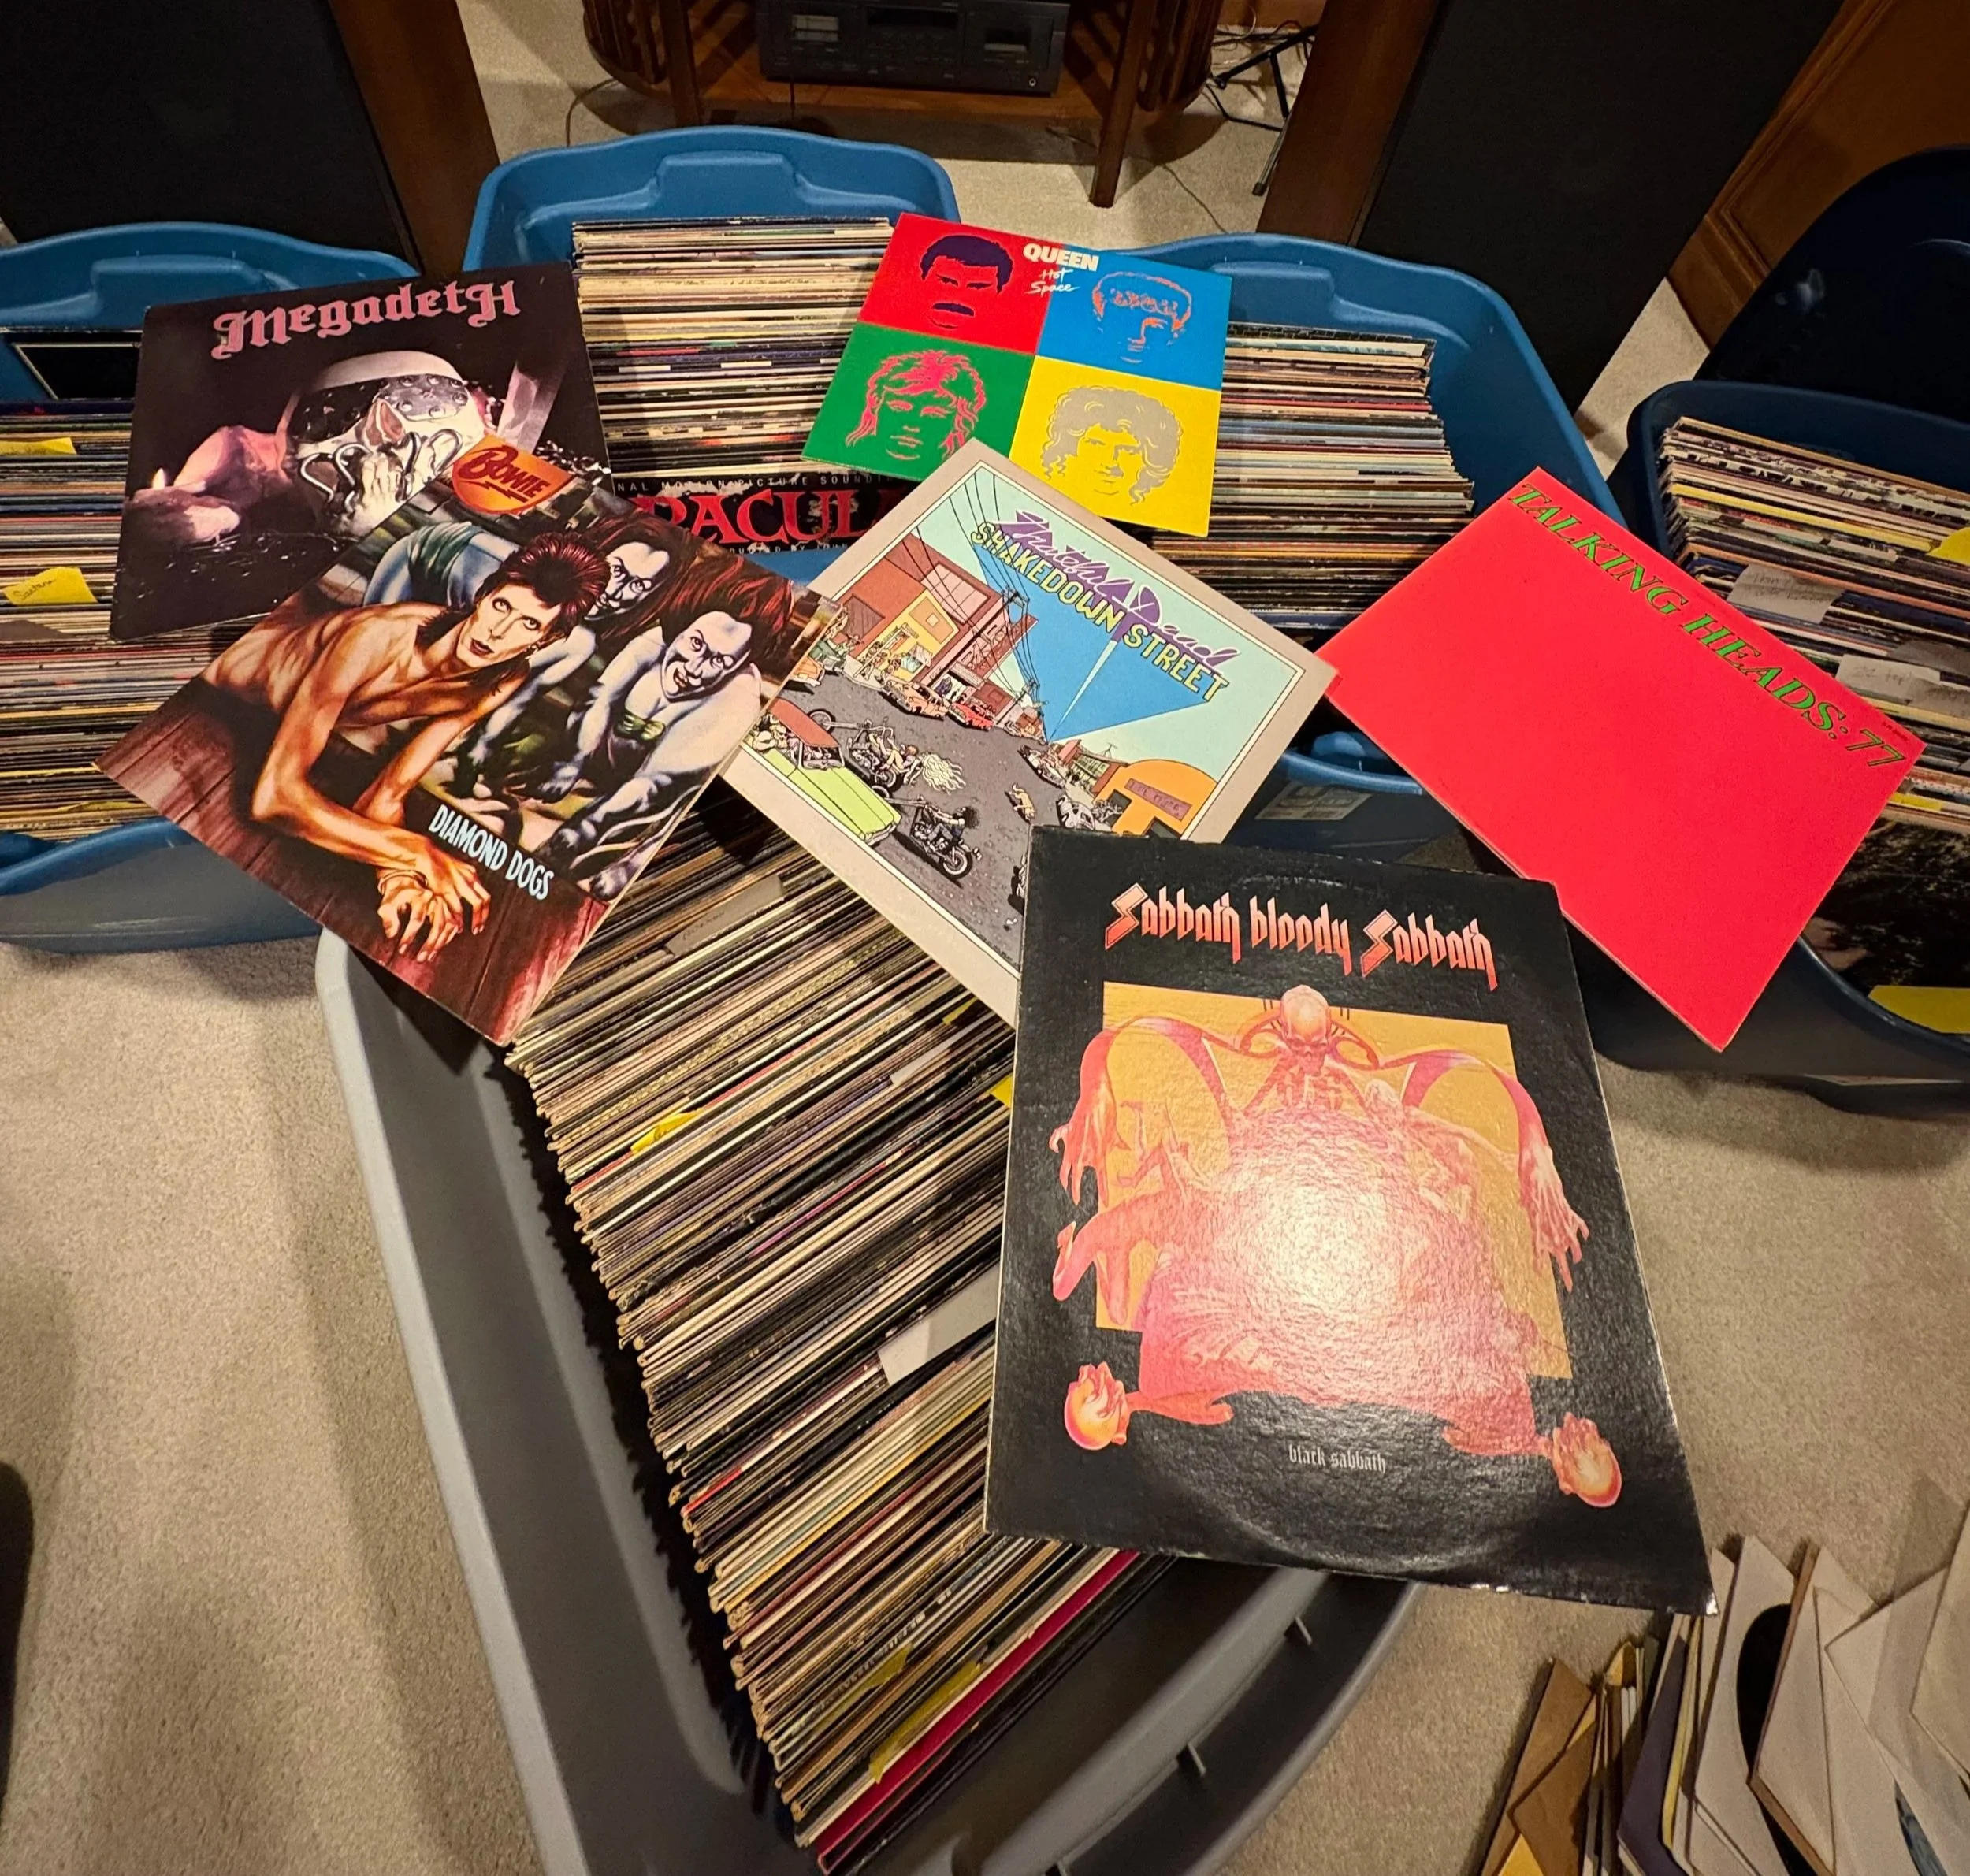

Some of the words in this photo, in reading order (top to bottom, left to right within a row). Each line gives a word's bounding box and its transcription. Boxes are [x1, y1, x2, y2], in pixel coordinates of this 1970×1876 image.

[1023, 243, 1100, 272] QUEEN
[1023, 280, 1081, 298] Space
[1038, 267, 1074, 284] Hot
[1508, 483, 1689, 615] TALKING
[971, 521, 1125, 633] SHAKEDOWN
[1123, 623, 1230, 703] STREET
[428, 804, 508, 871] DIAMOND
[505, 849, 554, 901] DOGS
[1105, 882, 1241, 964] Sabbath
[1249, 894, 1353, 976] bloody
[1360, 908, 1498, 991] Sabbath
[1288, 1443, 1326, 1467] black
[1330, 1449, 1387, 1474] sabbath
